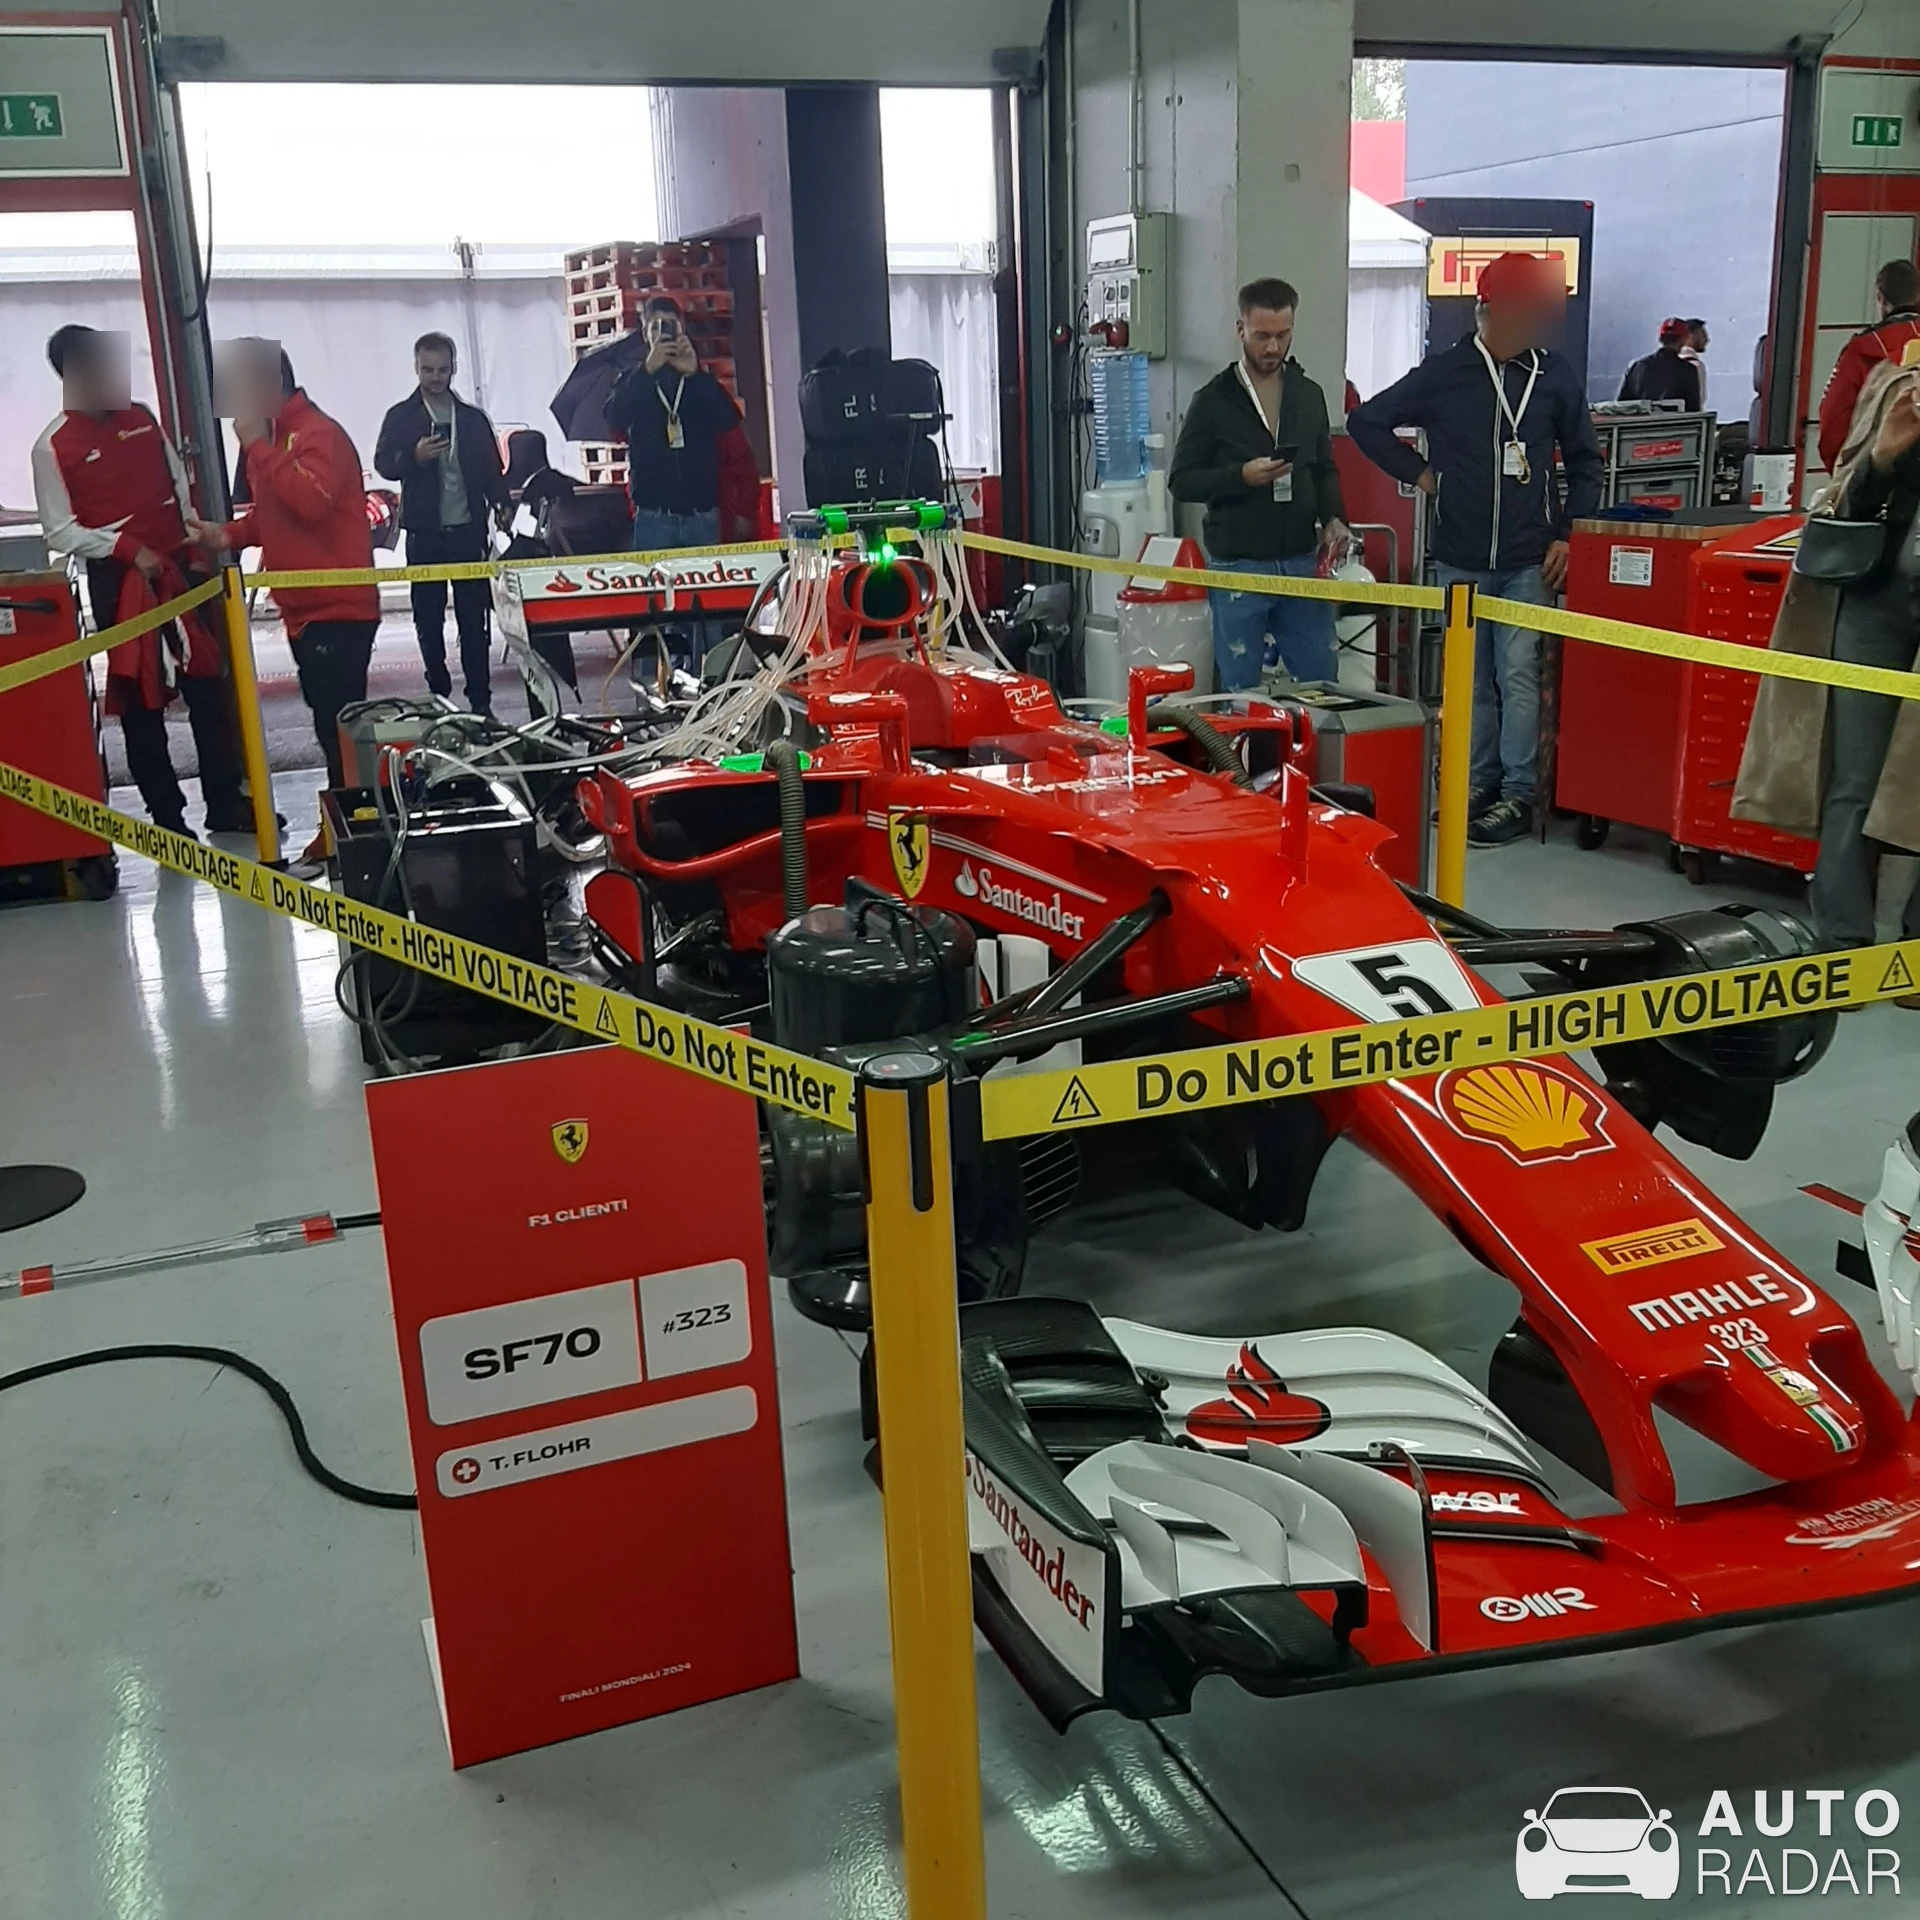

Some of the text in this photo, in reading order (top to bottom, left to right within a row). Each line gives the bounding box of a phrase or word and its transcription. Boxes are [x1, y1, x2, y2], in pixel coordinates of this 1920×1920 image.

[844, 394, 858, 418] FL
[855, 467, 868, 489] FR
[53, 789, 69, 818] Do
[70, 796, 91, 829] Not
[93, 805, 125, 842] Enter
[134, 821, 169, 861] HIGH
[172, 838, 241, 891] VOLTAGE
[978, 867, 1085, 941] Santander
[272, 876, 296, 913] Do
[300, 887, 332, 929] Not
[335, 901, 384, 948] Enter
[402, 924, 456, 977] HIGH
[460, 945, 578, 1022] VOLTAGE
[1350, 953, 1454, 1018] 5
[1137, 1063, 1207, 1111] Do
[1226, 1042, 1314, 1098] Not
[1331, 1028, 1463, 1080] Enter
[1508, 992, 1626, 1053] HIGH
[1641, 957, 1851, 1029] VOLTAGE
[635, 1007, 675, 1057] Do
[683, 1023, 738, 1081] Not
[746, 1045, 835, 1115] Enter
[528, 1198, 628, 1228] F1 CLIENTI
[1595, 1227, 1708, 1267] PIRELLI
[662, 1303, 732, 1335] #323
[1627, 1273, 1789, 1332] MAHLE
[1708, 1317, 1770, 1350] 323
[464, 1327, 601, 1381] SF70
[489, 1437, 591, 1471] T. FLOHR
[1825, 1497, 1895, 1523] ACTION
[1834, 1511, 1879, 1531] ROAD
[973, 1457, 1095, 1632] Santander
[559, 1686, 600, 1703] FINALI
[601, 1670, 661, 1692] MONDIALI
